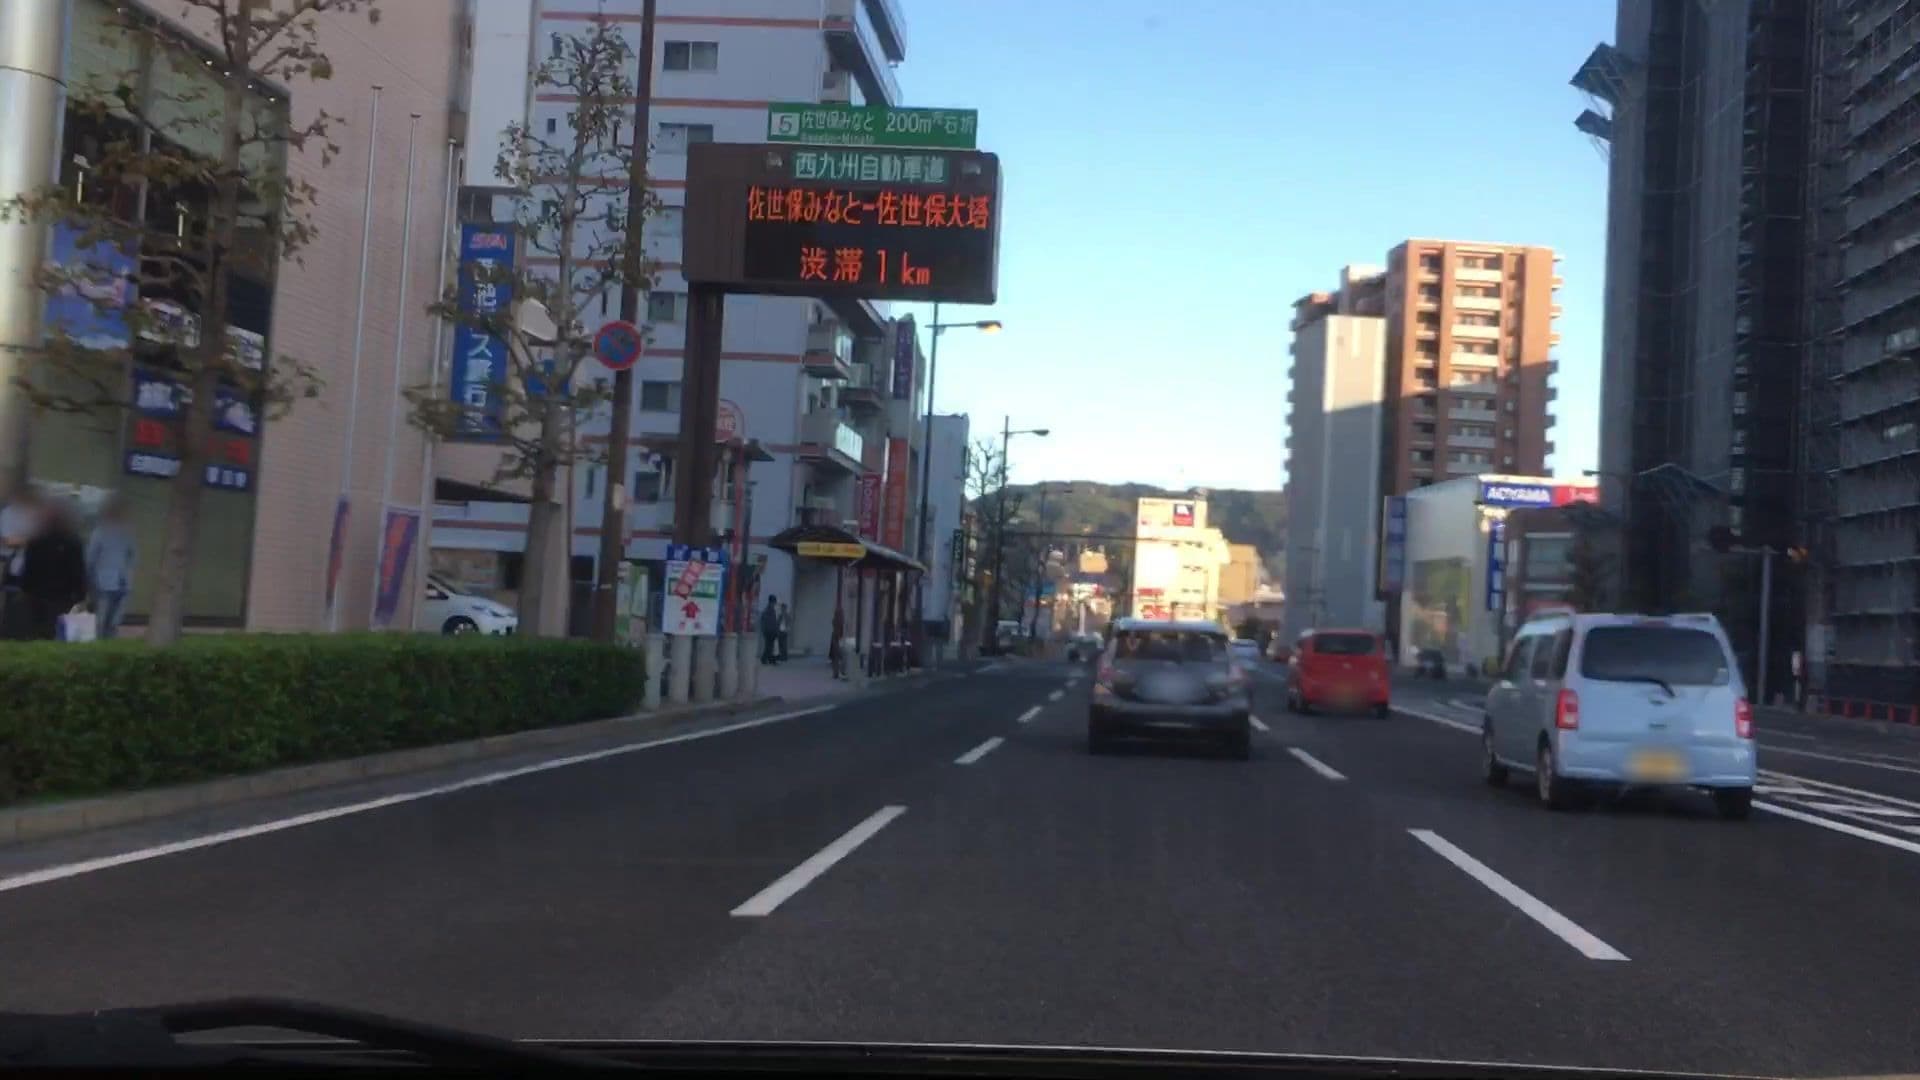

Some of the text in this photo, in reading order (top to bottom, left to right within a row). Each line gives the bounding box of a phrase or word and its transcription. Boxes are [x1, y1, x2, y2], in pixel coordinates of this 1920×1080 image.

[779, 115, 793, 134] 5
[801, 111, 875, 132] 佐世保みなと
[795, 152, 945, 183] 西九州自動車道
[800, 248, 863, 281] 渋滞
[902, 251, 931, 285] km
